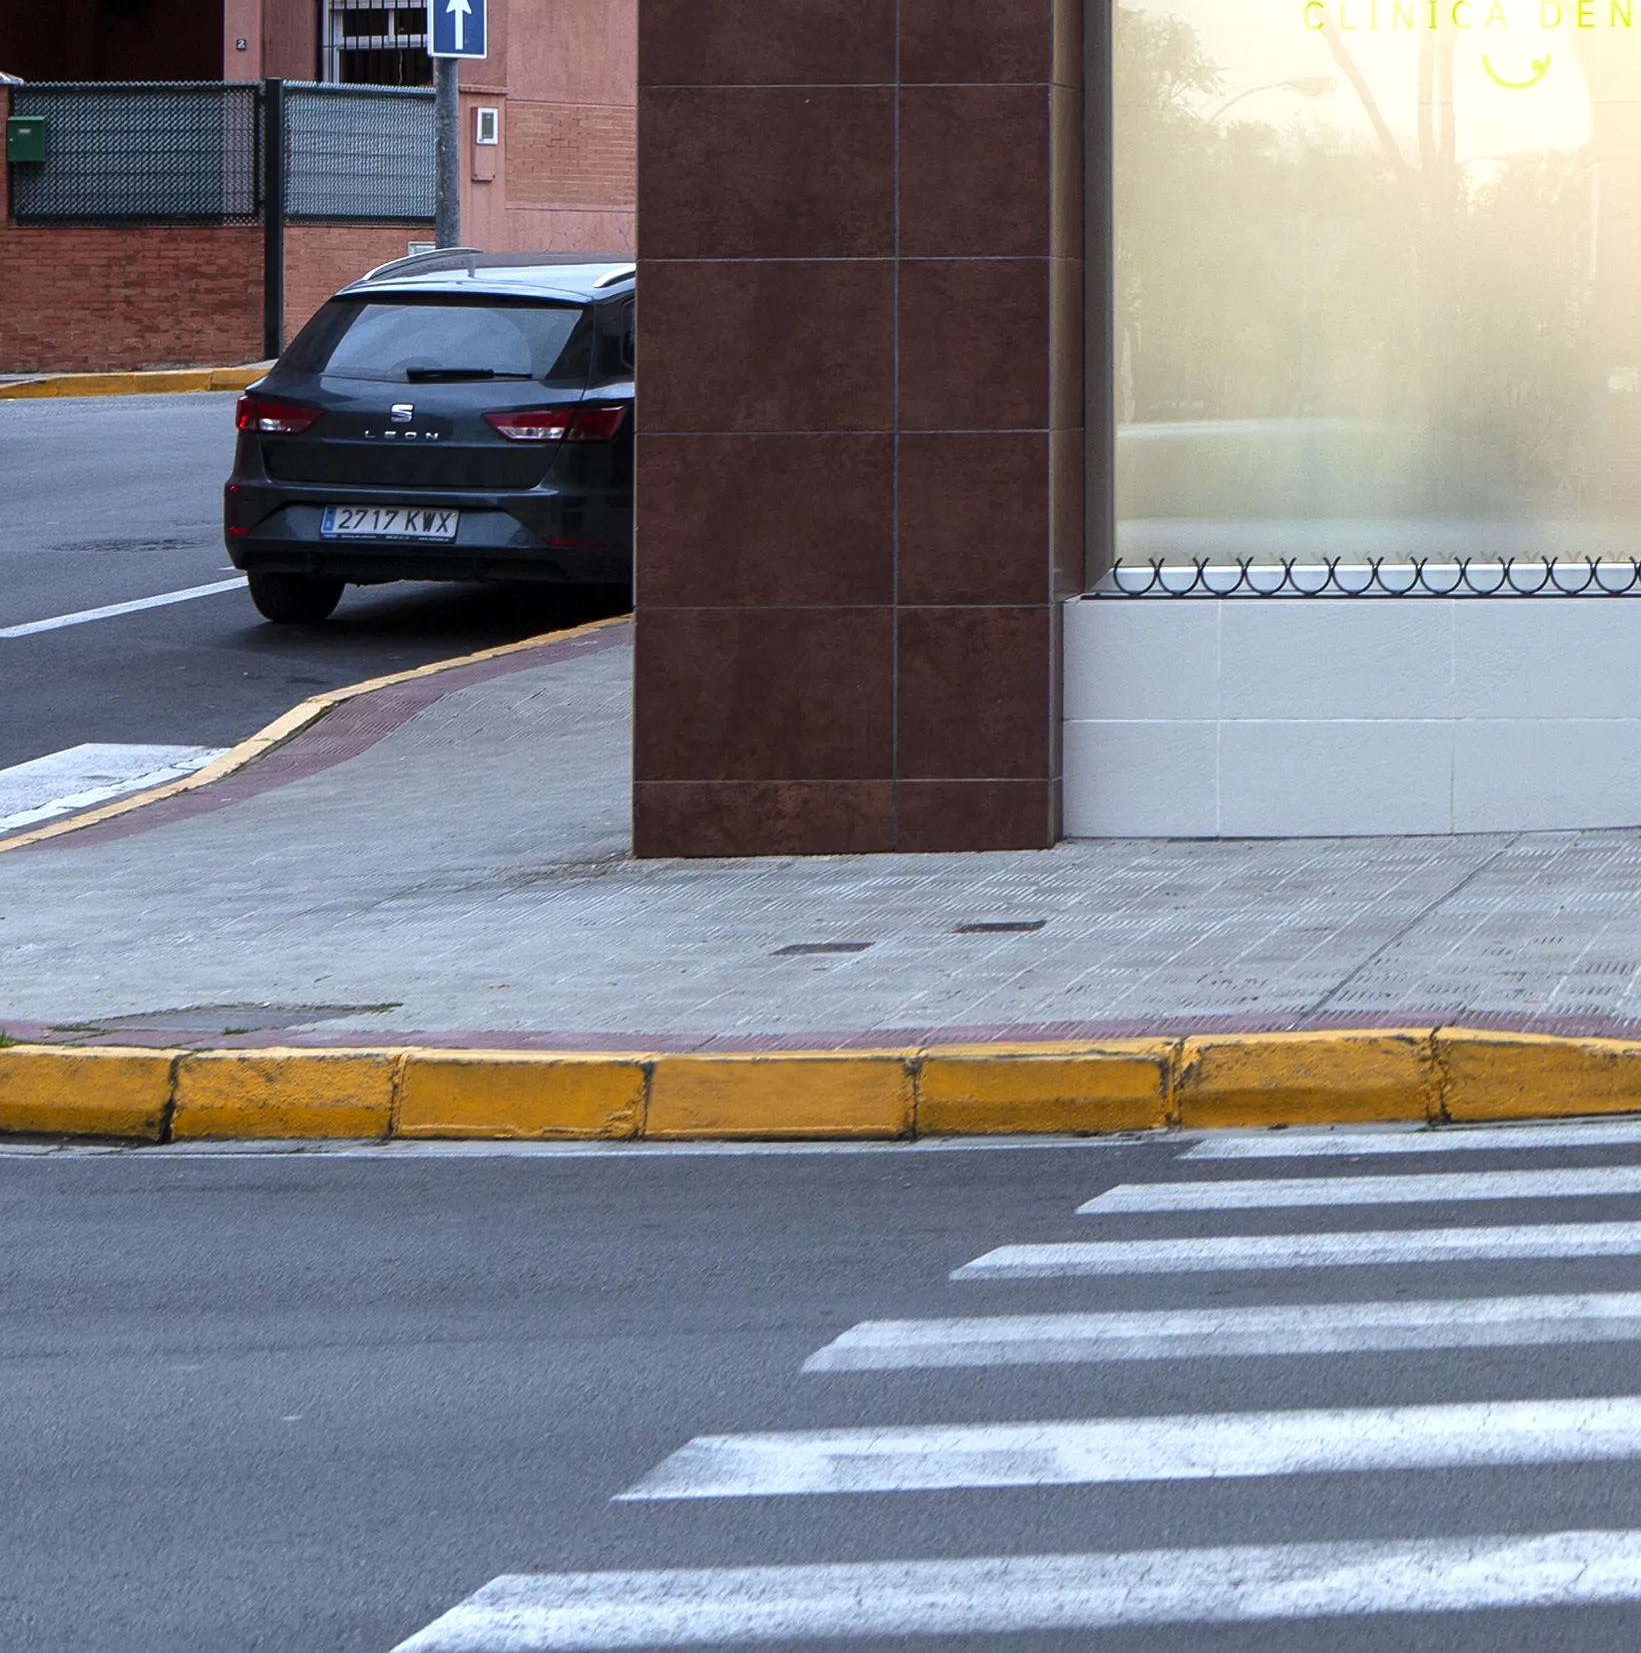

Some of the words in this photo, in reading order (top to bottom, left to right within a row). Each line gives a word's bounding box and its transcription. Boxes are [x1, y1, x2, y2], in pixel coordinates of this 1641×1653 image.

[237, 39, 246, 49] 2
[364, 430, 439, 440] LEON
[338, 508, 399, 531] 2717
[404, 510, 453, 533] KWX
